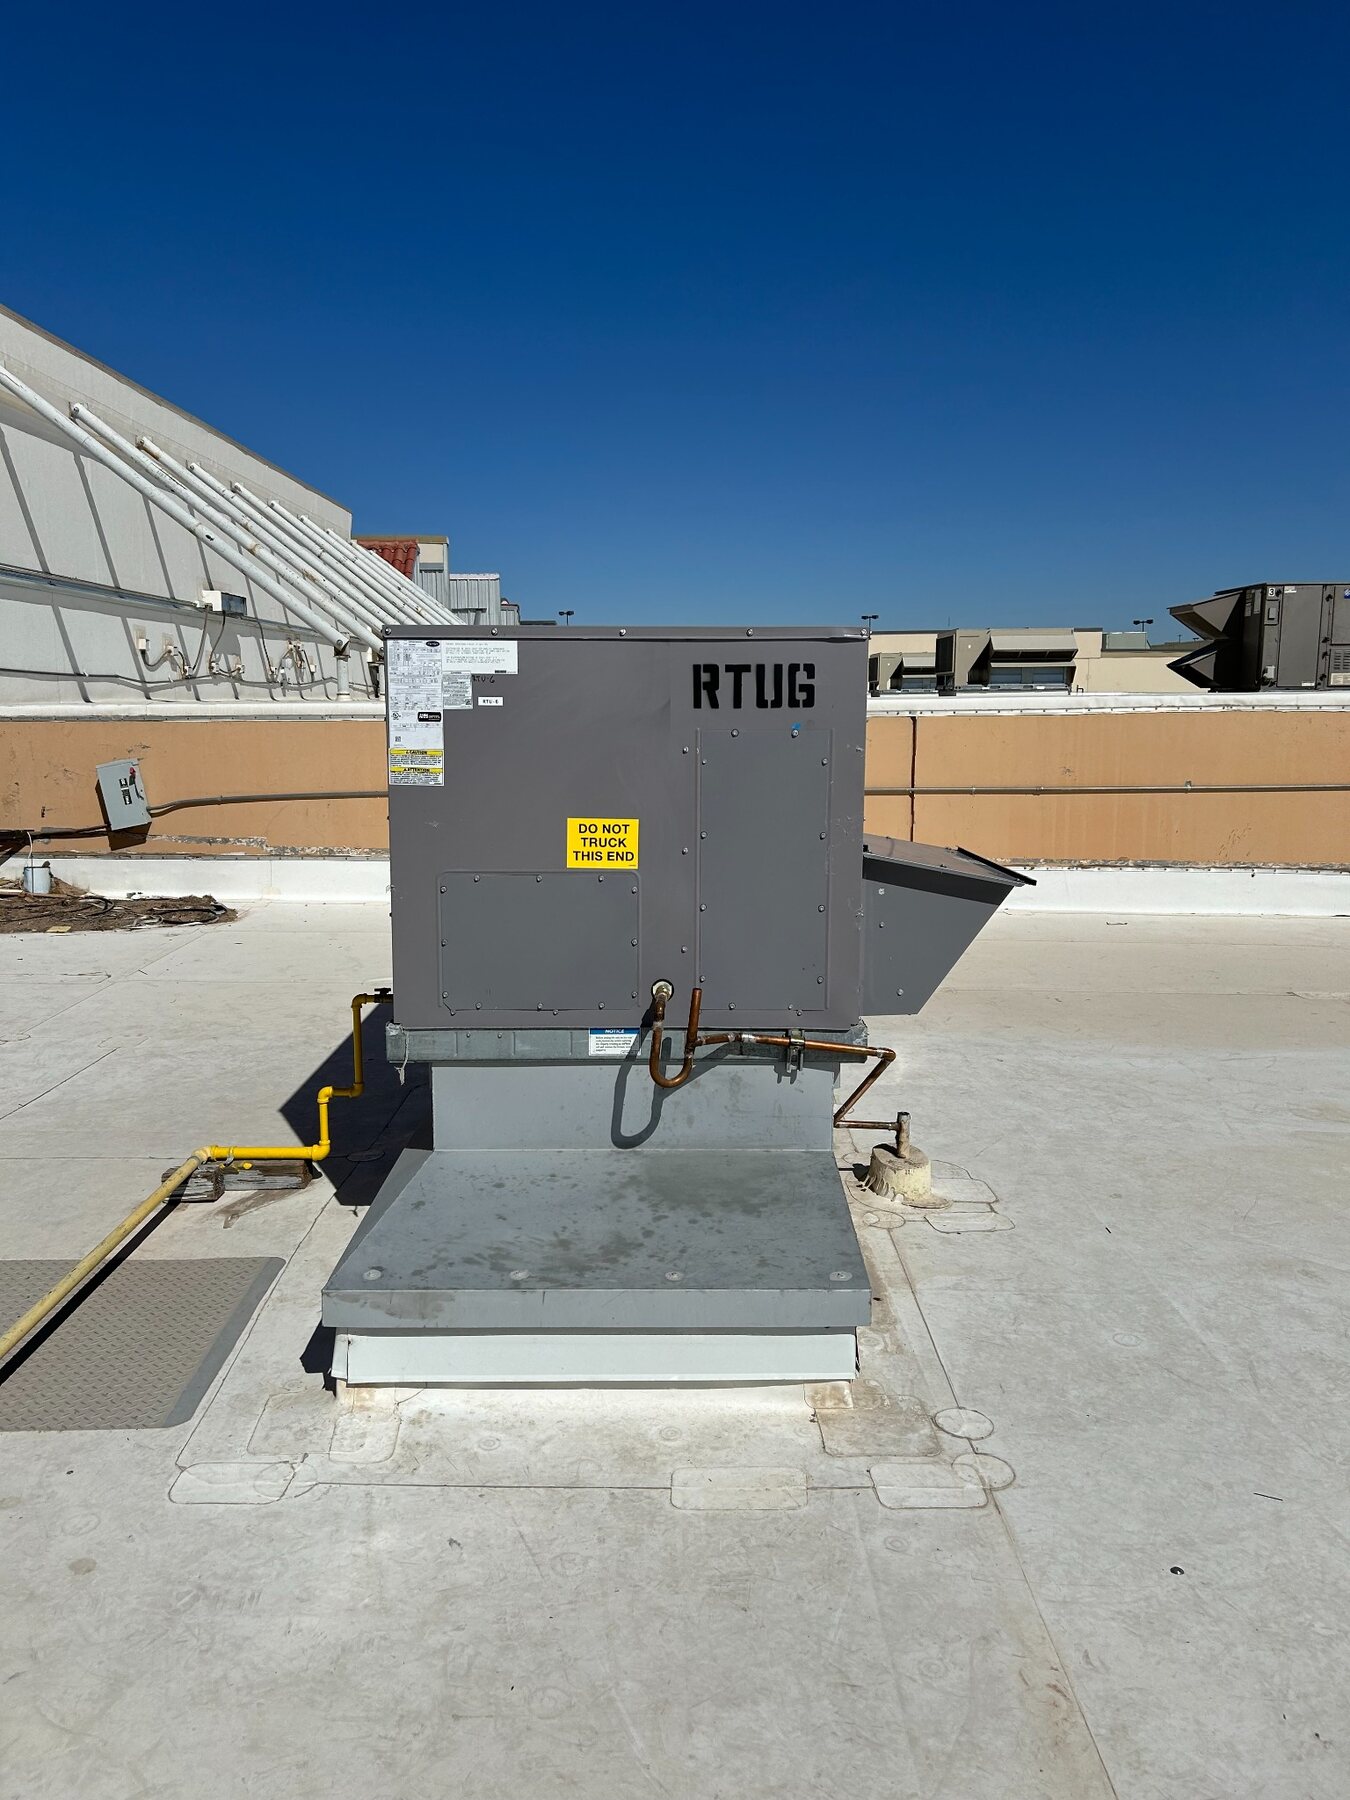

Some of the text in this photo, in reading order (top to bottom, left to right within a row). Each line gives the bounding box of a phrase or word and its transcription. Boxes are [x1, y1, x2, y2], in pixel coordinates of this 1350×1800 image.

[1269, 588, 1275, 596] 3
[578, 823, 630, 834] DO NOT
[581, 837, 627, 848] TRUCK
[573, 850, 634, 861] THIS END
